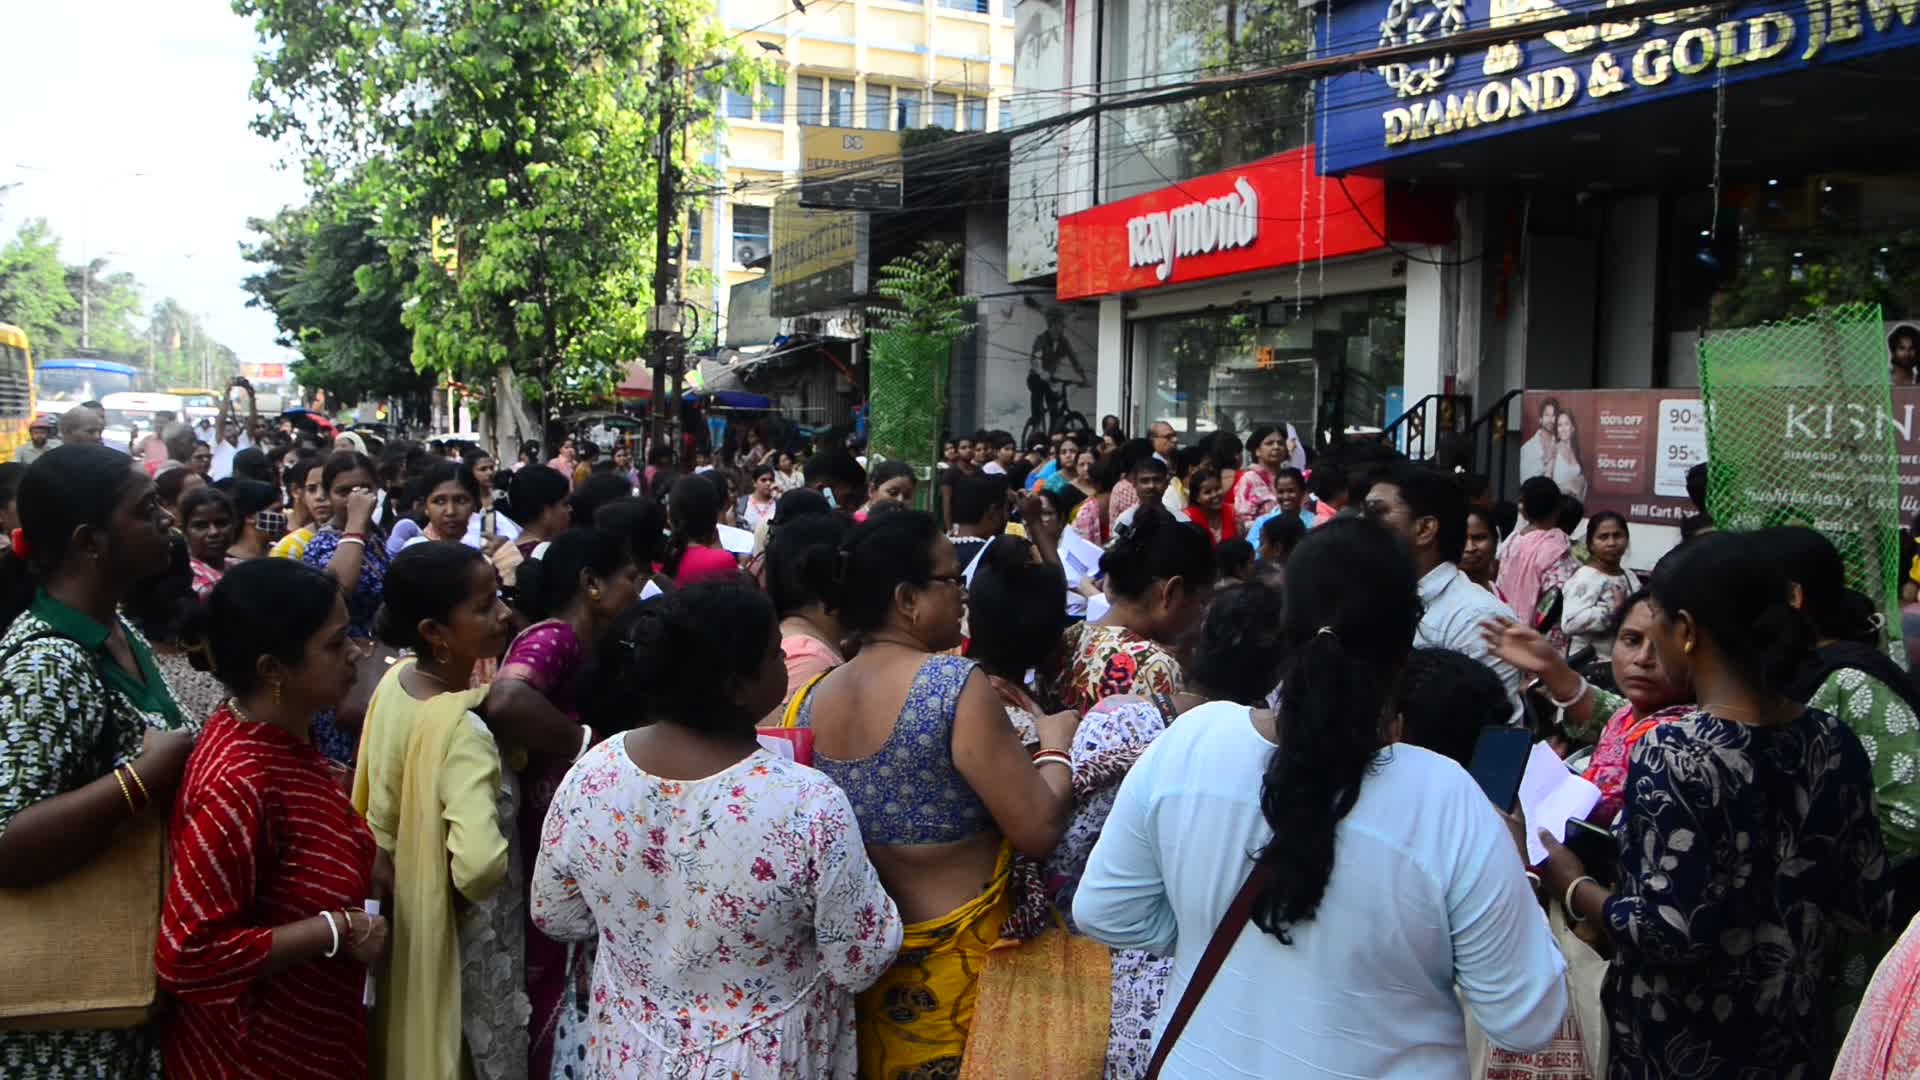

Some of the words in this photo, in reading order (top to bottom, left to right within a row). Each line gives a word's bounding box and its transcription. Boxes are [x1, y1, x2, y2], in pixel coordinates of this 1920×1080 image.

[1383, 67, 1579, 147] DIAMOND
[1587, 51, 1630, 97] &
[1632, 11, 1797, 86] GOLD
[1624, 415, 1643, 425] OFF
[1617, 458, 1637, 469] OFF
[1630, 504, 1648, 517] Hill
[1650, 505, 1672, 518] Cart
